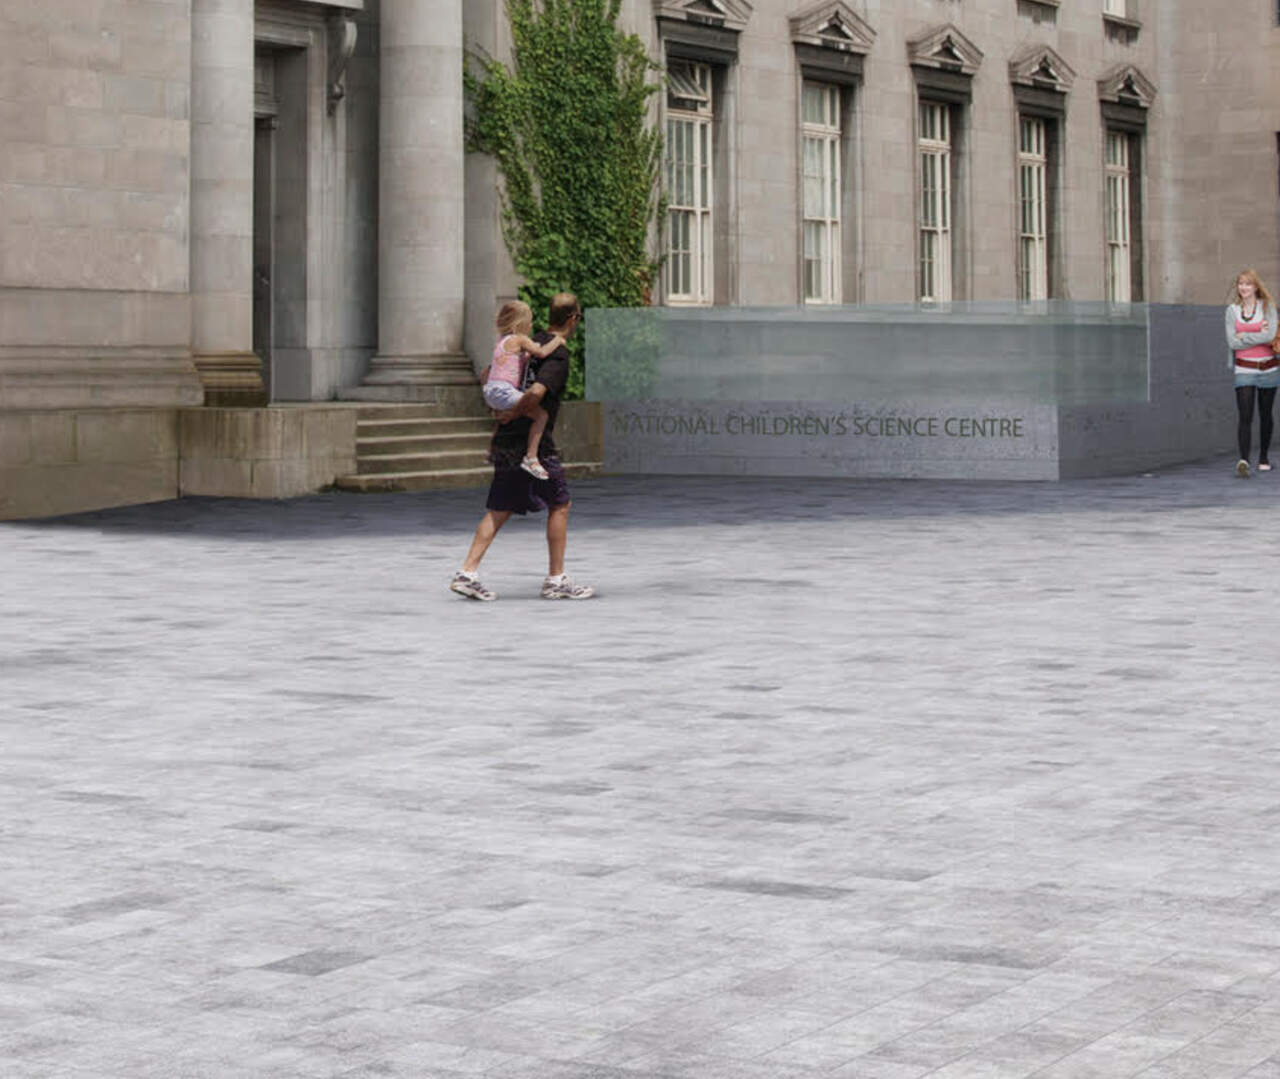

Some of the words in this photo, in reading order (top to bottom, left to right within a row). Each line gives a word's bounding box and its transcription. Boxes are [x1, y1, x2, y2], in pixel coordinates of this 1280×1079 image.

[614, 416, 719, 436] NATIONAL
[726, 415, 848, 437] CHILDREN'S
[853, 417, 939, 438] SCIENCE
[944, 417, 1024, 439] CENTRE
